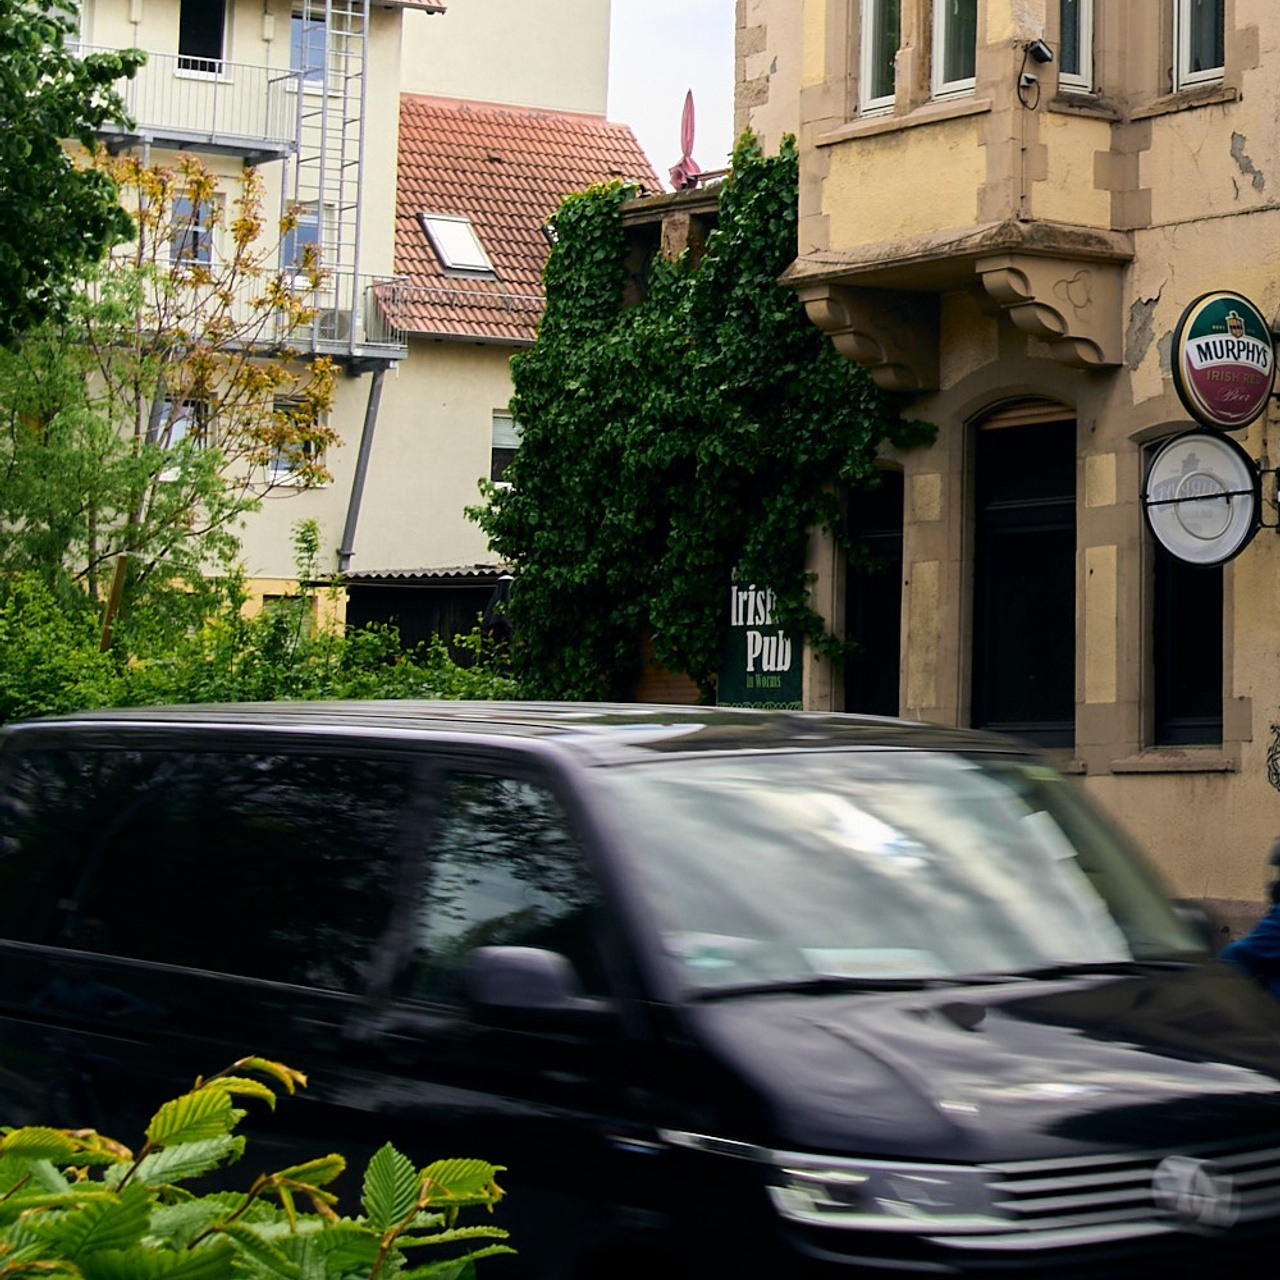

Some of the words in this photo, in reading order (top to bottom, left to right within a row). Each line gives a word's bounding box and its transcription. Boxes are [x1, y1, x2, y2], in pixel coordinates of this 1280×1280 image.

[1206, 370, 1239, 382] IRISH
[1243, 373, 1262, 385] RED
[746, 629, 792, 672] Pub
[755, 674, 781, 689] Worms
